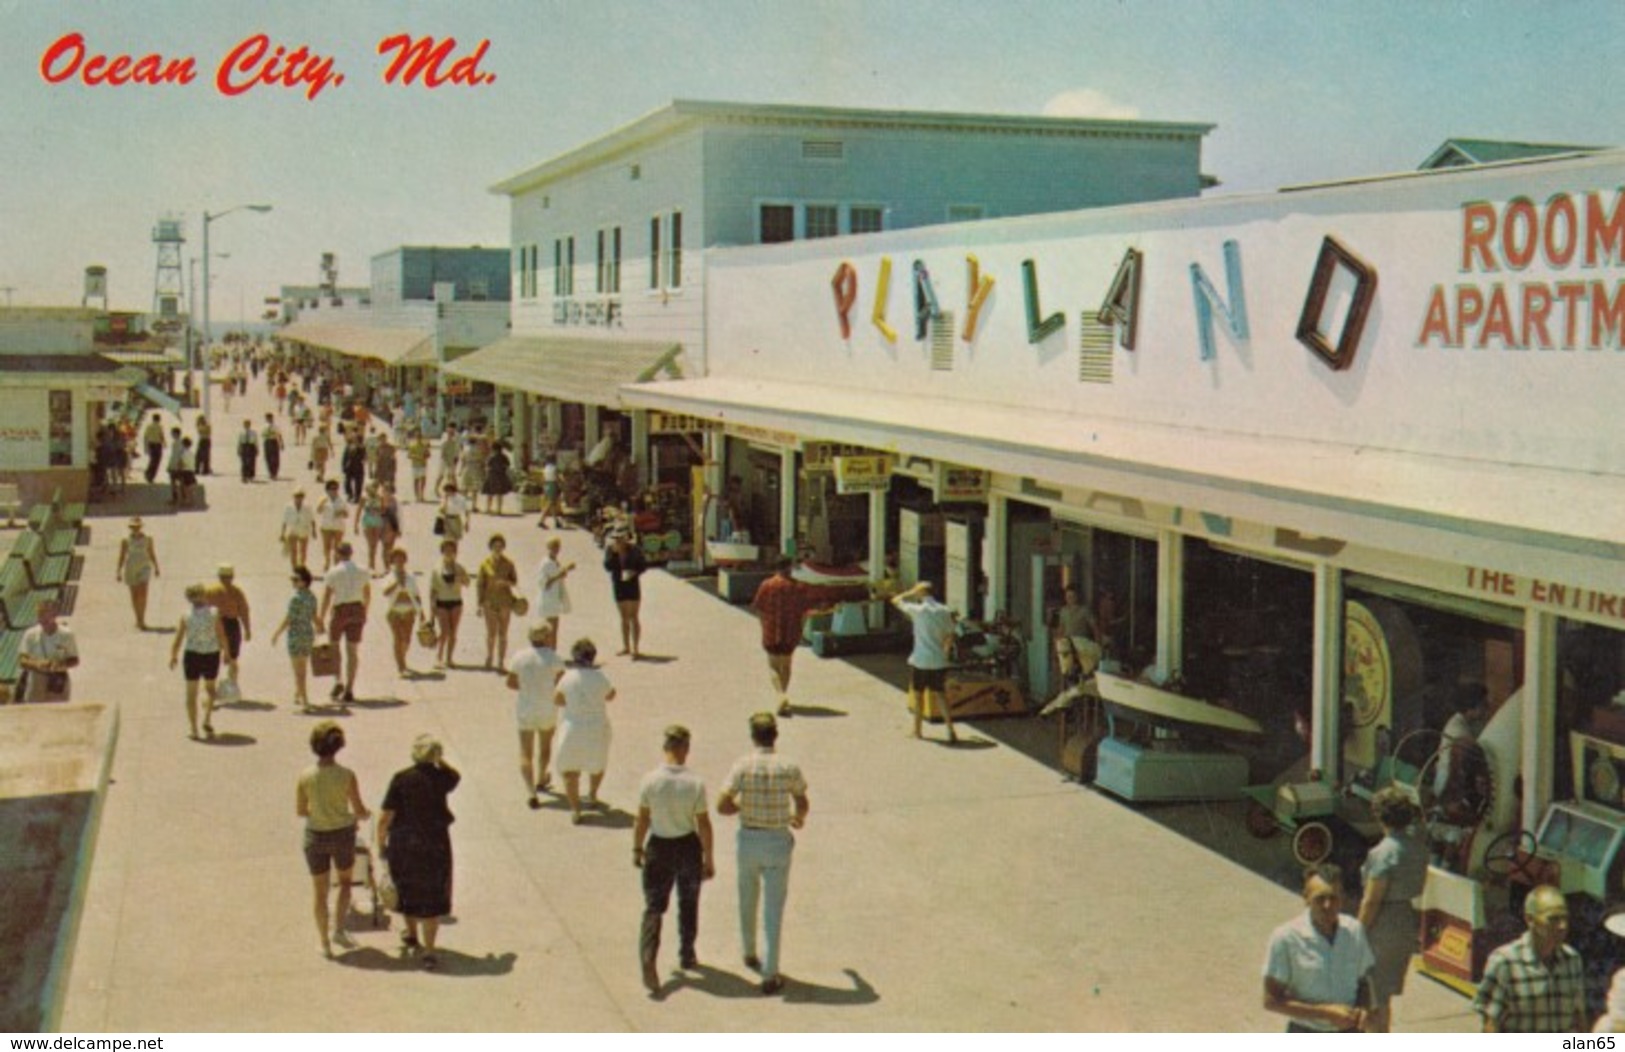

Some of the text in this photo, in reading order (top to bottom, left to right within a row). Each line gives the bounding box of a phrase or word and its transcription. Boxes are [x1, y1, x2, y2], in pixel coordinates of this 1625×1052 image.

[1461, 188, 1625, 272] ROOM
[1415, 279, 1625, 349] APARTM
[1465, 566, 1516, 596] THE
